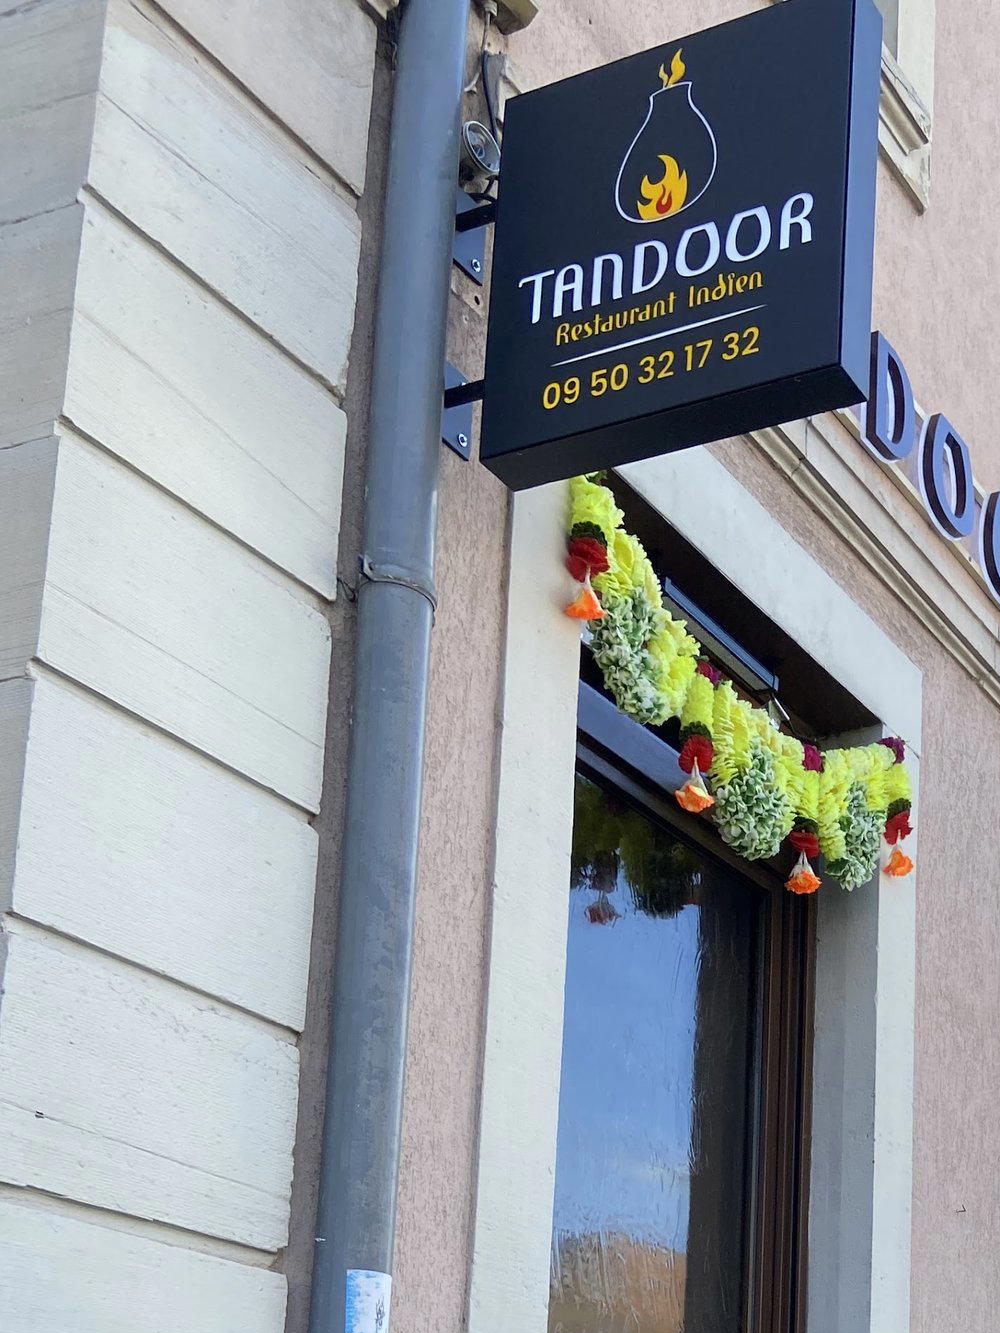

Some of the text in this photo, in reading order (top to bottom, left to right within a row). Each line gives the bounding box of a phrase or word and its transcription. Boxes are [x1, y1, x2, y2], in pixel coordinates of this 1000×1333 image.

[518, 192, 814, 324] TANDOOR
[555, 271, 763, 346] Restaurant Indien
[542, 326, 760, 410] 09 50 32 17 32
